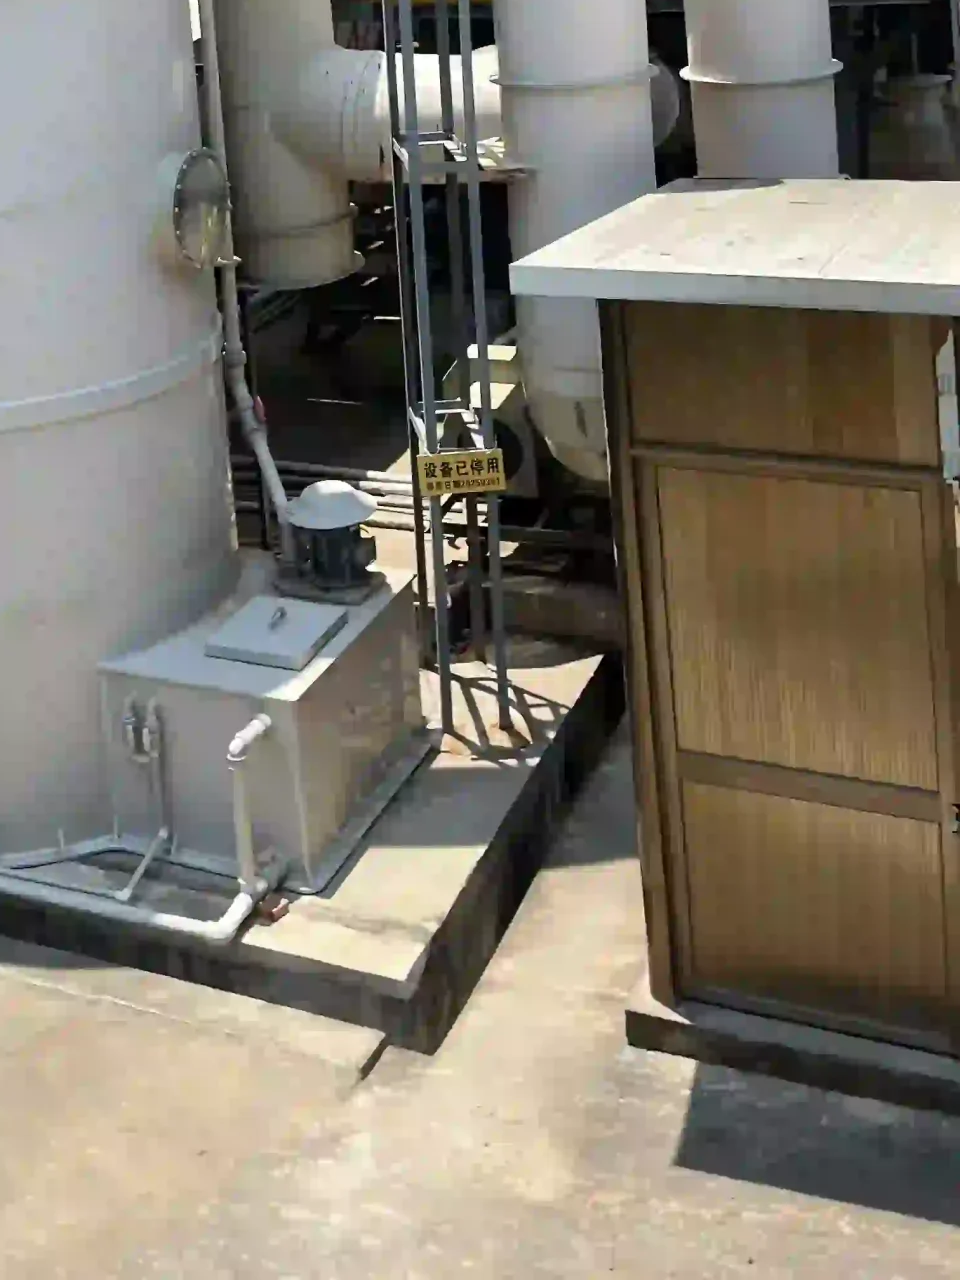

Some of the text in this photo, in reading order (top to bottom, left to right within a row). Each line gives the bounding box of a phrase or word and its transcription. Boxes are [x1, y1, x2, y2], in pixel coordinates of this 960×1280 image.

[424, 458, 500, 478] 设备已停用
